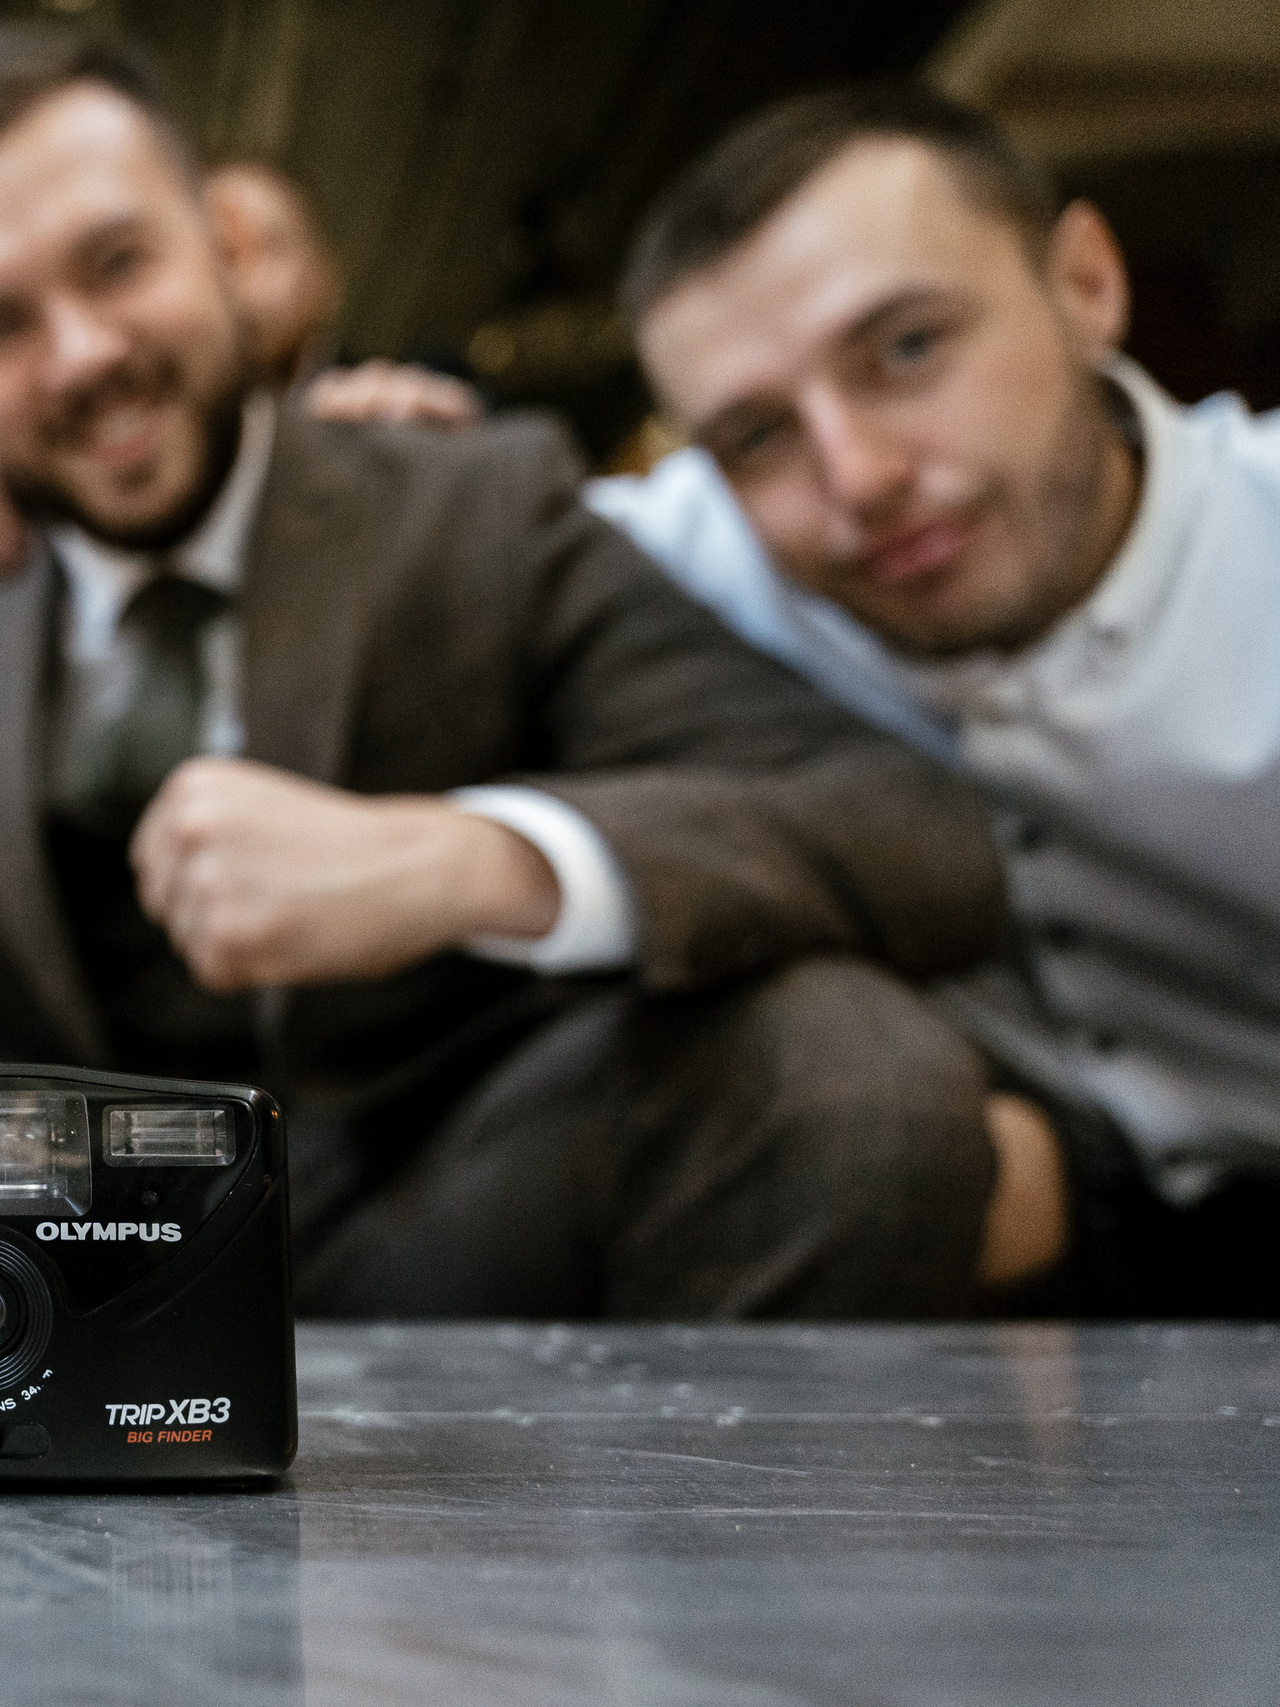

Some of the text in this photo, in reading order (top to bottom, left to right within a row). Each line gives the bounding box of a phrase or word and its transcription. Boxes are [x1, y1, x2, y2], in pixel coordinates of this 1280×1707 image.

[35, 1221, 182, 1242] OLYMPUS
[105, 1397, 231, 1425] TRIP XB3
[127, 1429, 213, 1443] BIG FINDER
